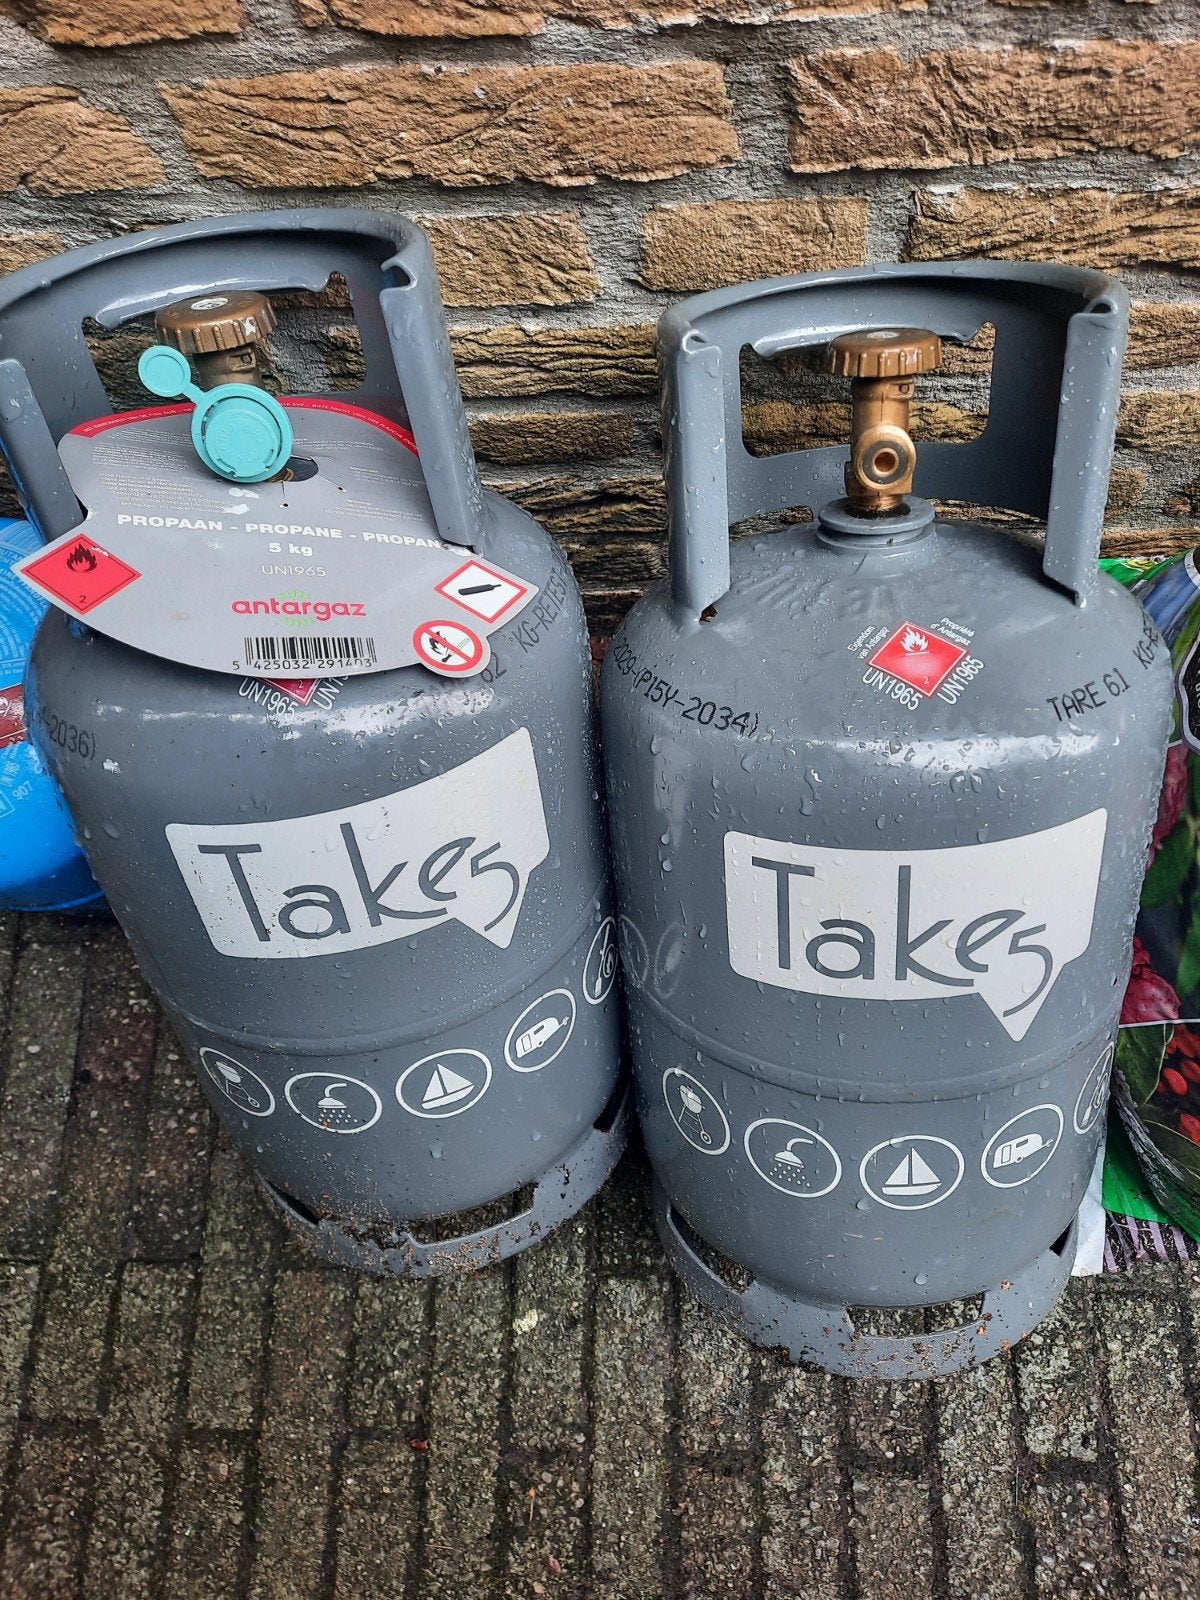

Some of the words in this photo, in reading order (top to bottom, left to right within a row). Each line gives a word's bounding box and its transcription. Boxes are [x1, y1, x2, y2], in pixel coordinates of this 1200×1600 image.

[117, 513, 224, 531] PROPAAN
[245, 522, 344, 539] PROPANE
[362, 531, 442, 550] PROPAN
[268, 542, 282, 553] 5
[288, 542, 314, 557] kg
[261, 564, 327, 577] UN1965
[79, 595, 88, 604] 2
[231, 597, 367, 622] antargaz
[847, 625, 876, 652] Eigendom
[941, 617, 976, 638] Propriété
[232, 660, 241, 670] 5
[253, 659, 311, 670] 425032
[862, 668, 924, 711] UN1965
[923, 676, 930, 685] 2
[936, 655, 985, 705] UN1965
[238, 677, 299, 721] UN1965
[1045, 681, 1107, 722] TARE
[12, 780, 34, 800] 907
